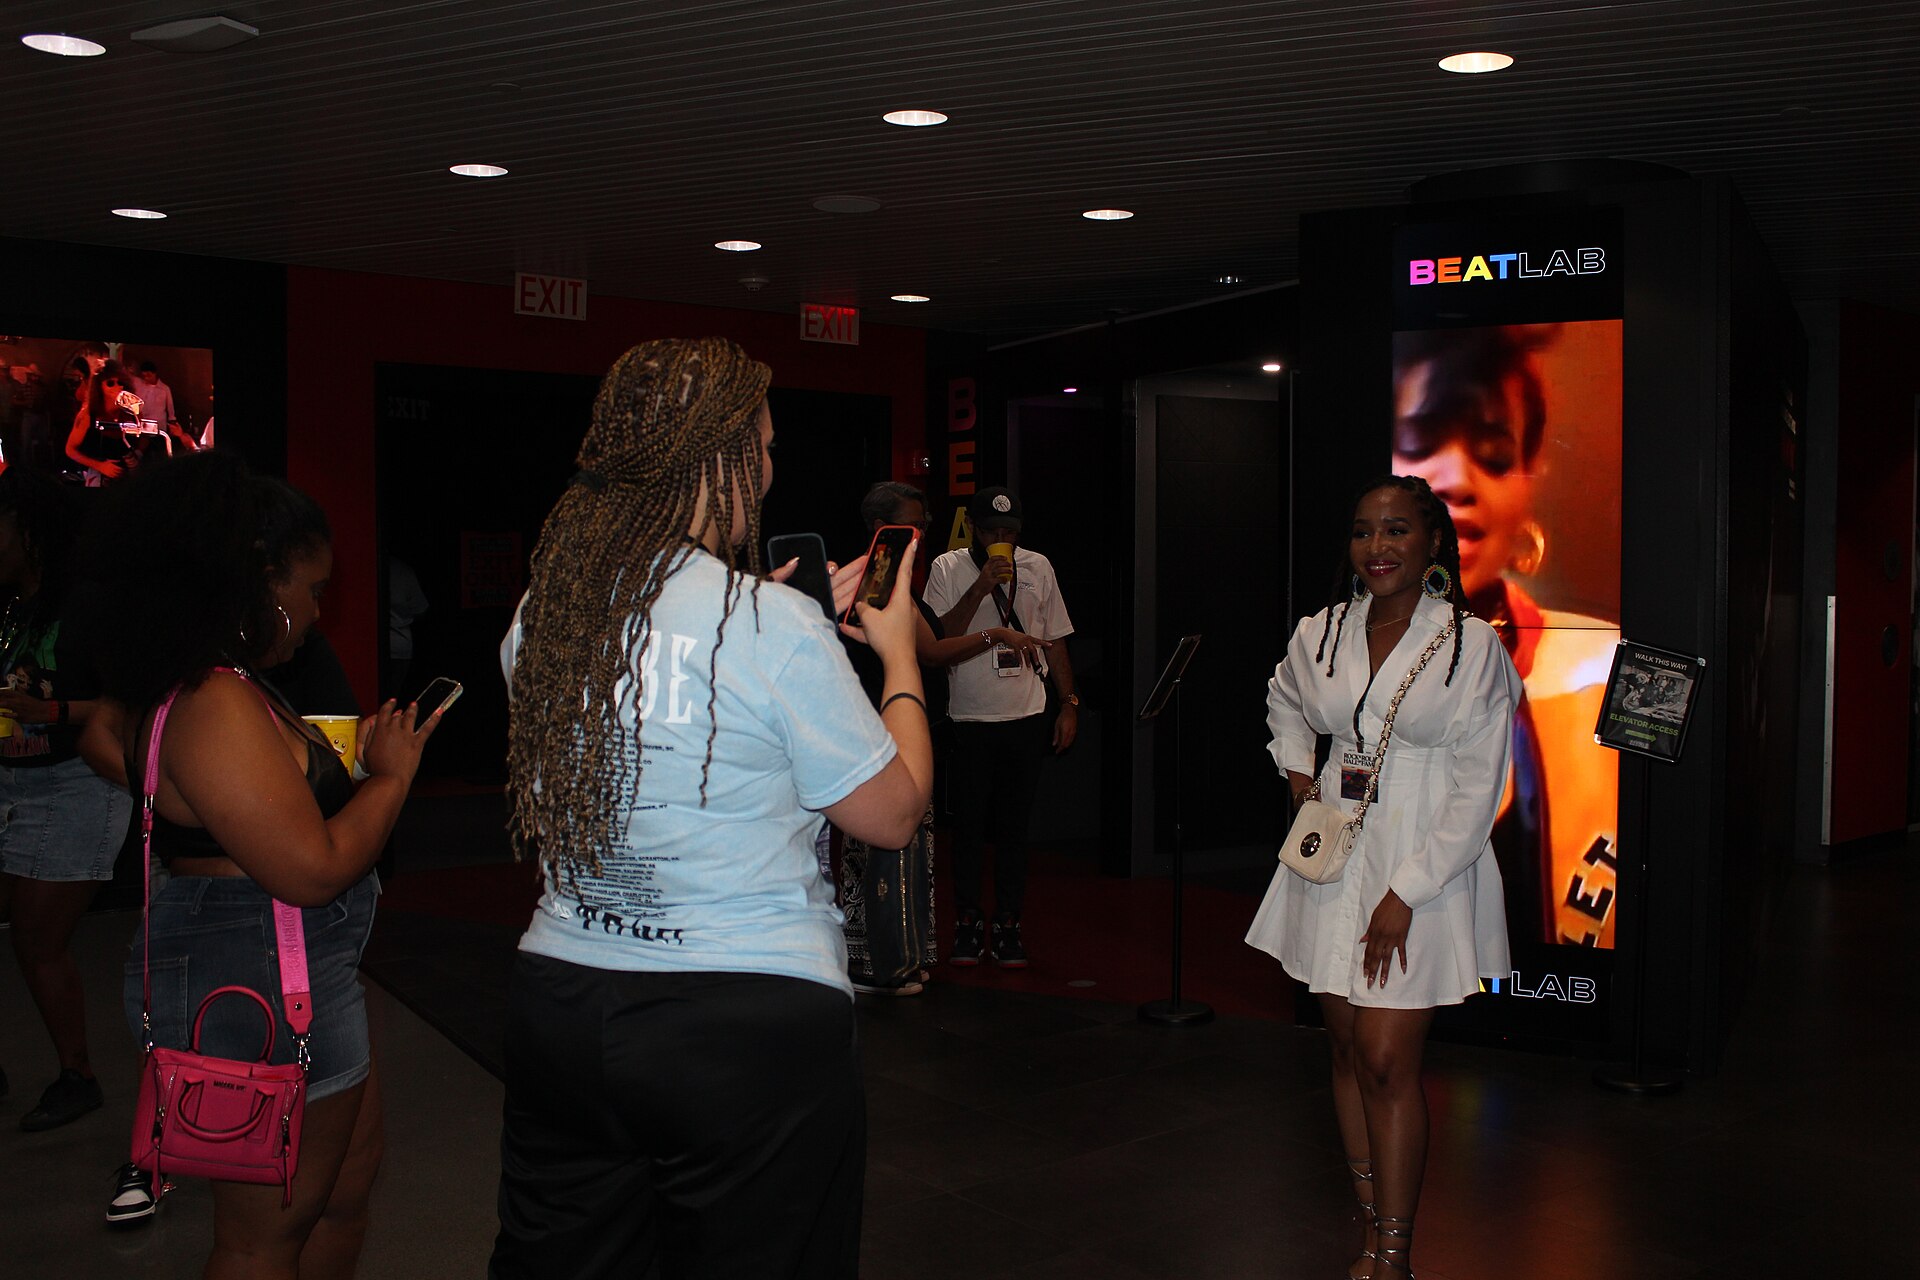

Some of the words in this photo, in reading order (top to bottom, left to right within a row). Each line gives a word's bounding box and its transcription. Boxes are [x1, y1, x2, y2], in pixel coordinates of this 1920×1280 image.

[520, 275, 583, 316] EXIT
[804, 305, 856, 342] EXIT
[1634, 652, 1655, 664] WALK
[1654, 657, 1670, 667] THIS
[1670, 661, 1688, 671] WAY!
[1609, 713, 1649, 728] ELEVATOR
[1648, 723, 1679, 737] ACCESS
